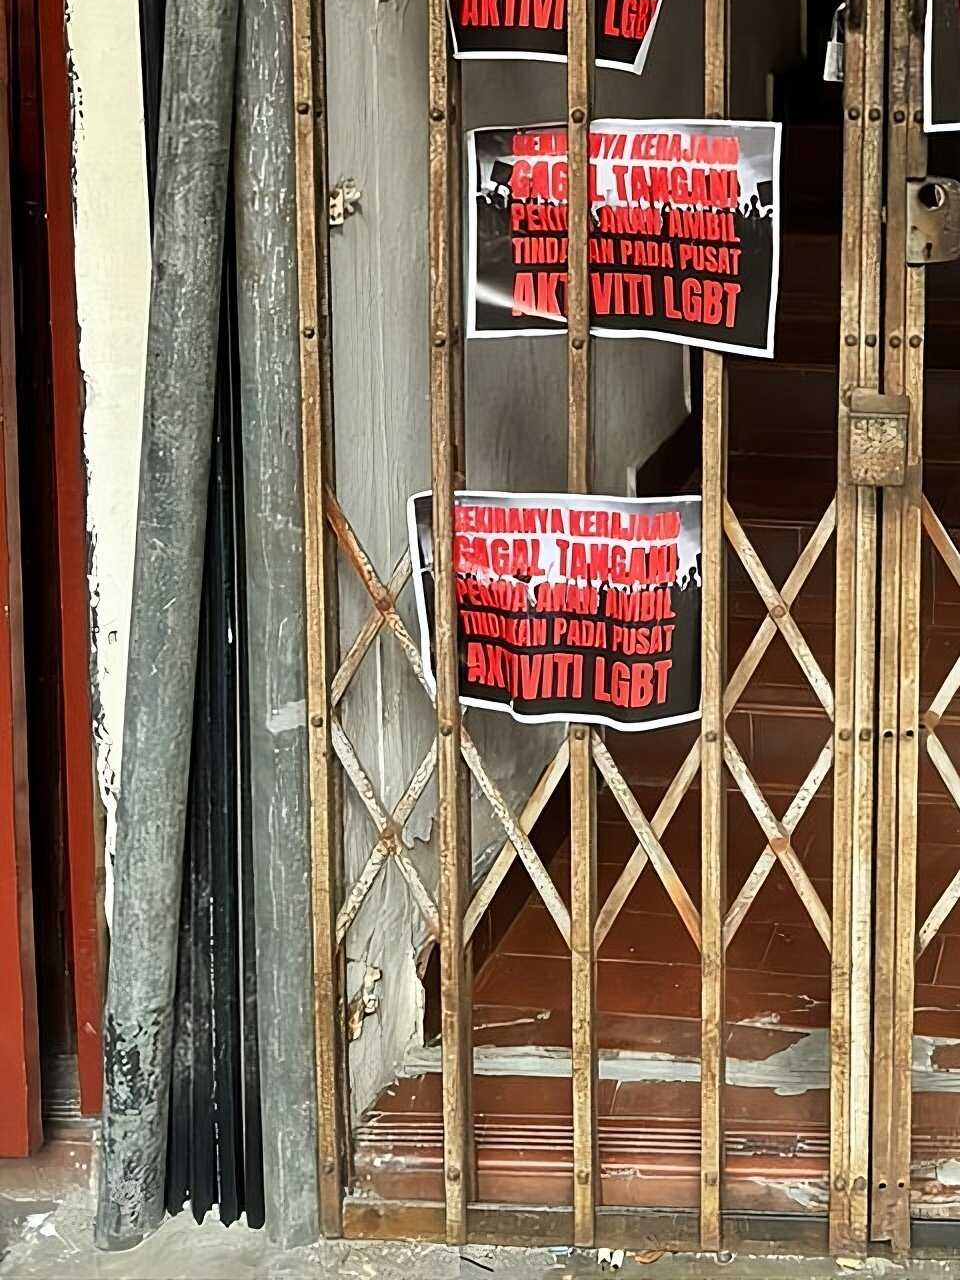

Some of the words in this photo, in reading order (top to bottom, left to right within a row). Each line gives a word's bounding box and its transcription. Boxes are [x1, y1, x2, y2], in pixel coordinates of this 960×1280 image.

[511, 160, 606, 202] GAGL
[612, 164, 739, 208] TANGANI
[669, 211, 740, 242] AMBIL
[621, 239, 674, 268] PADA
[680, 243, 741, 276] PUSAT
[512, 272, 653, 317] AKTVITI
[663, 276, 741, 328] LGBT
[556, 539, 678, 584] TANGANI
[606, 589, 676, 622] AMBIL
[553, 618, 606, 649] PADA
[612, 624, 675, 656] PUSAT
[594, 656, 672, 709] LGBT
